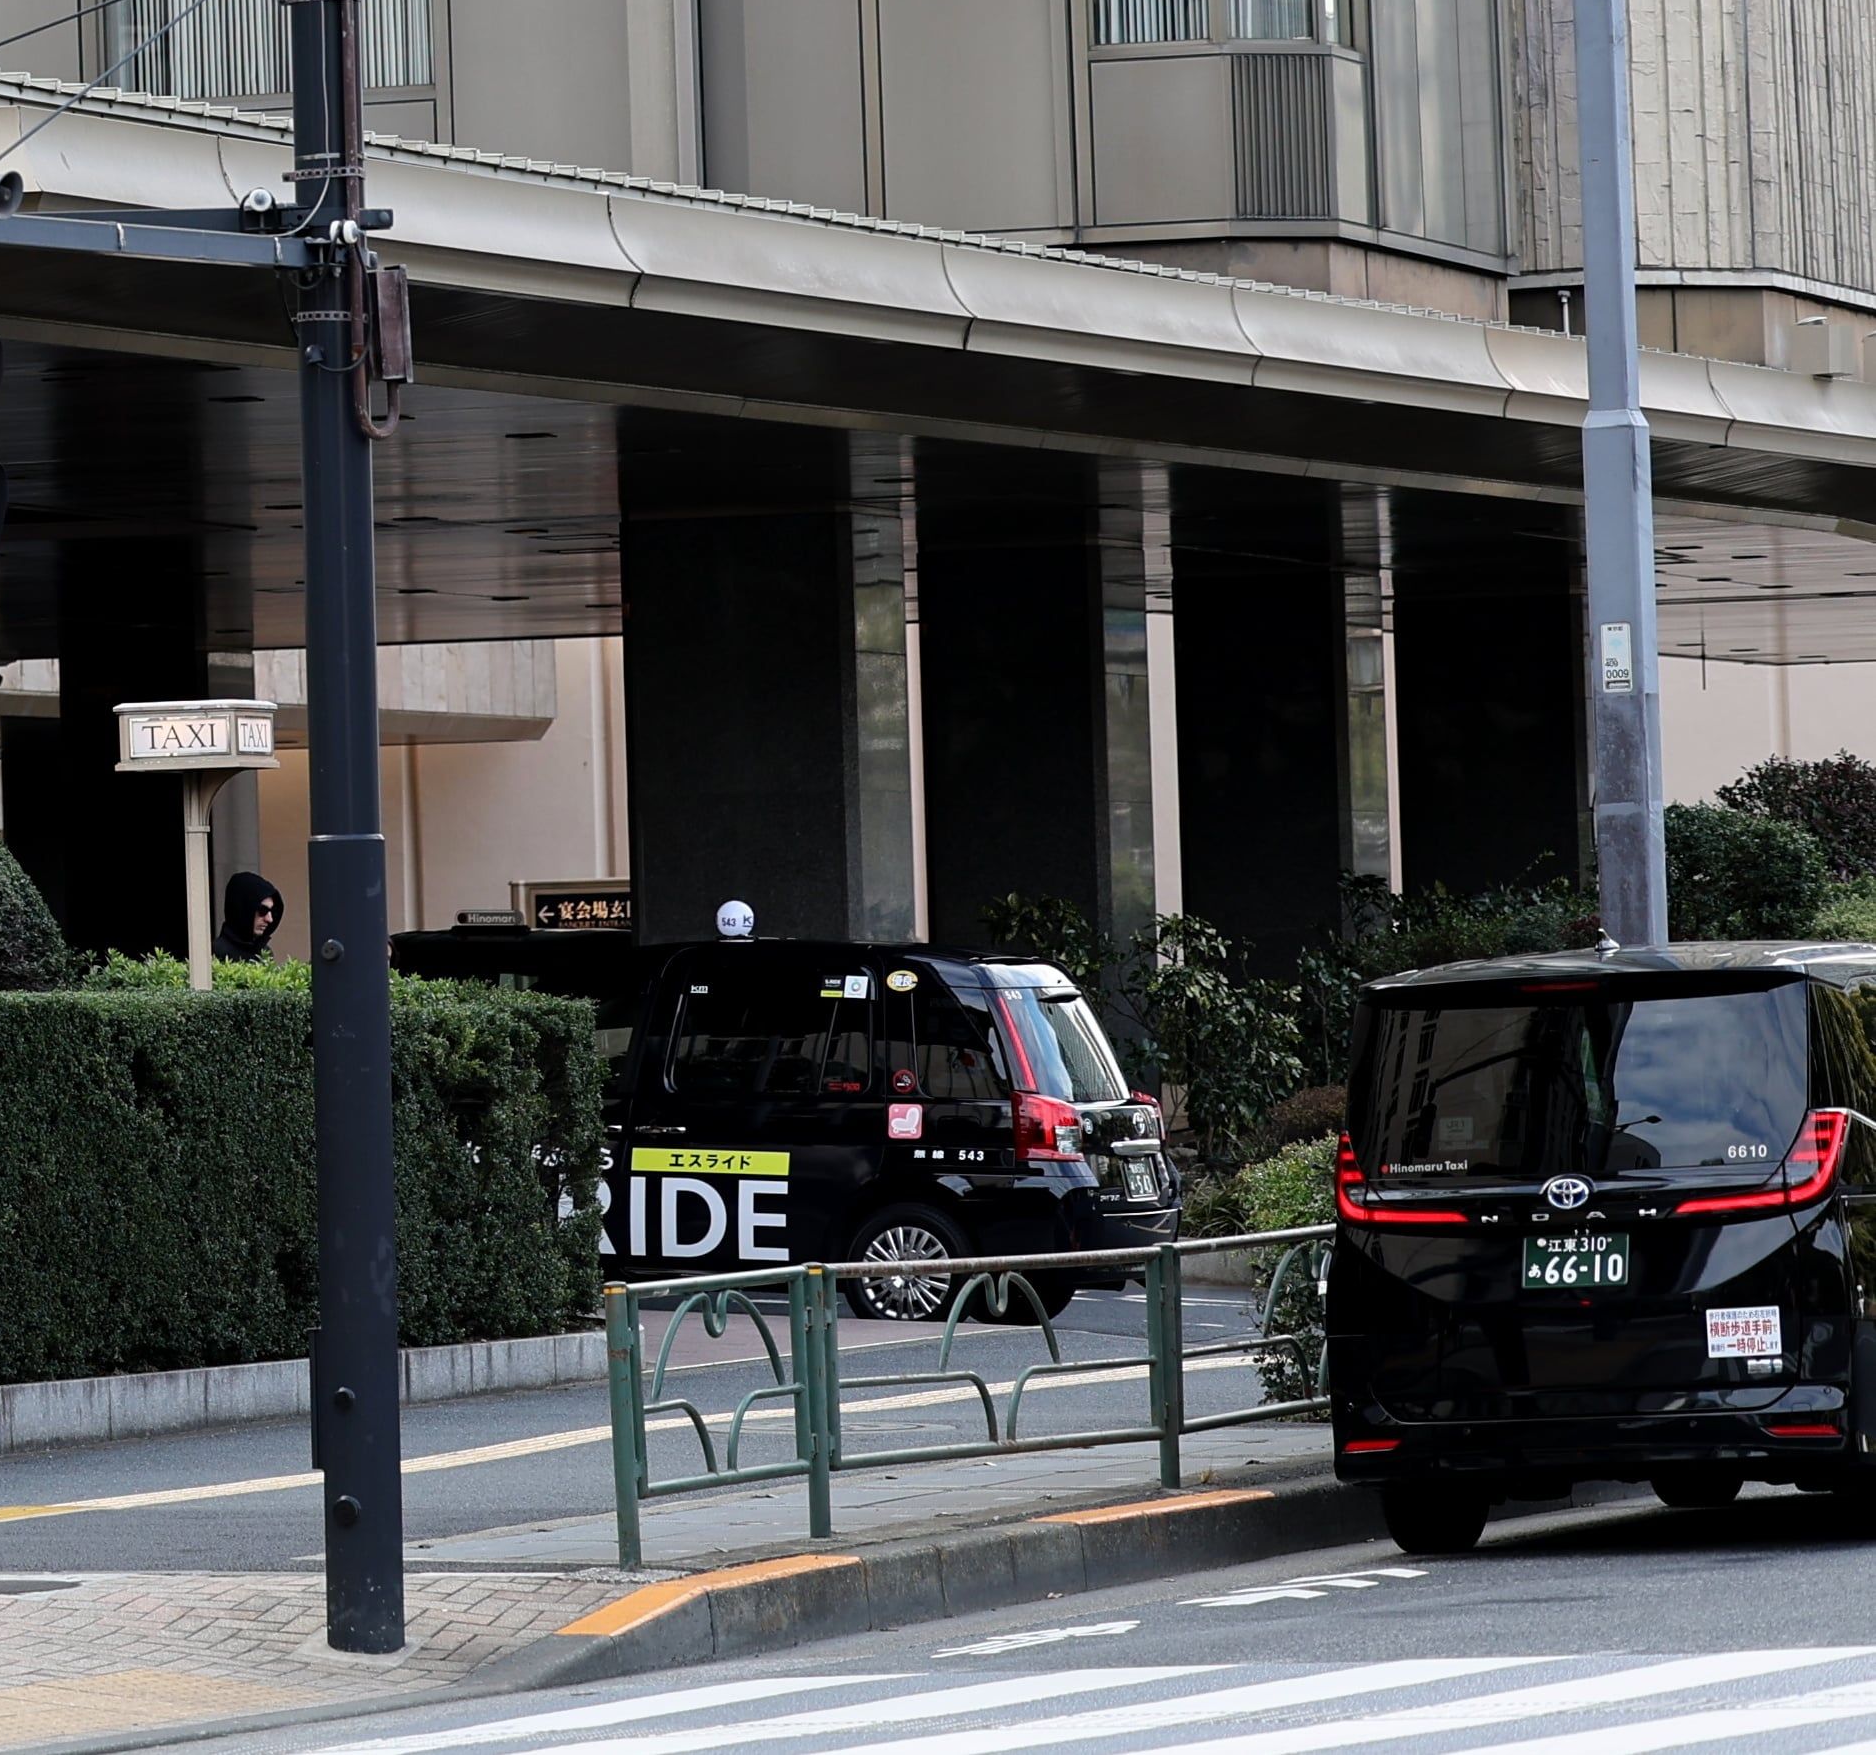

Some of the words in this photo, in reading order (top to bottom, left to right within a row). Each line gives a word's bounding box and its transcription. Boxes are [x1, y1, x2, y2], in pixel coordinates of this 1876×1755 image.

[142, 723, 217, 750] TAXI
[240, 723, 268, 748] TAXI
[558, 900, 631, 920] 宴会場玄
[721, 917, 737, 927] 543
[1004, 990, 1023, 1000] 543
[958, 1149, 985, 1162] 543
[1727, 1144, 1767, 1158] 6610
[669, 1153, 752, 1170] エスライド
[1389, 1162, 1443, 1174] Hinomaru
[1444, 1159, 1468, 1171] Taxi
[1548, 1238, 1578, 1253] 江東
[1579, 1237, 1607, 1252] 310
[1528, 1263, 1542, 1278] あ
[1544, 1253, 1623, 1284] 66-10
